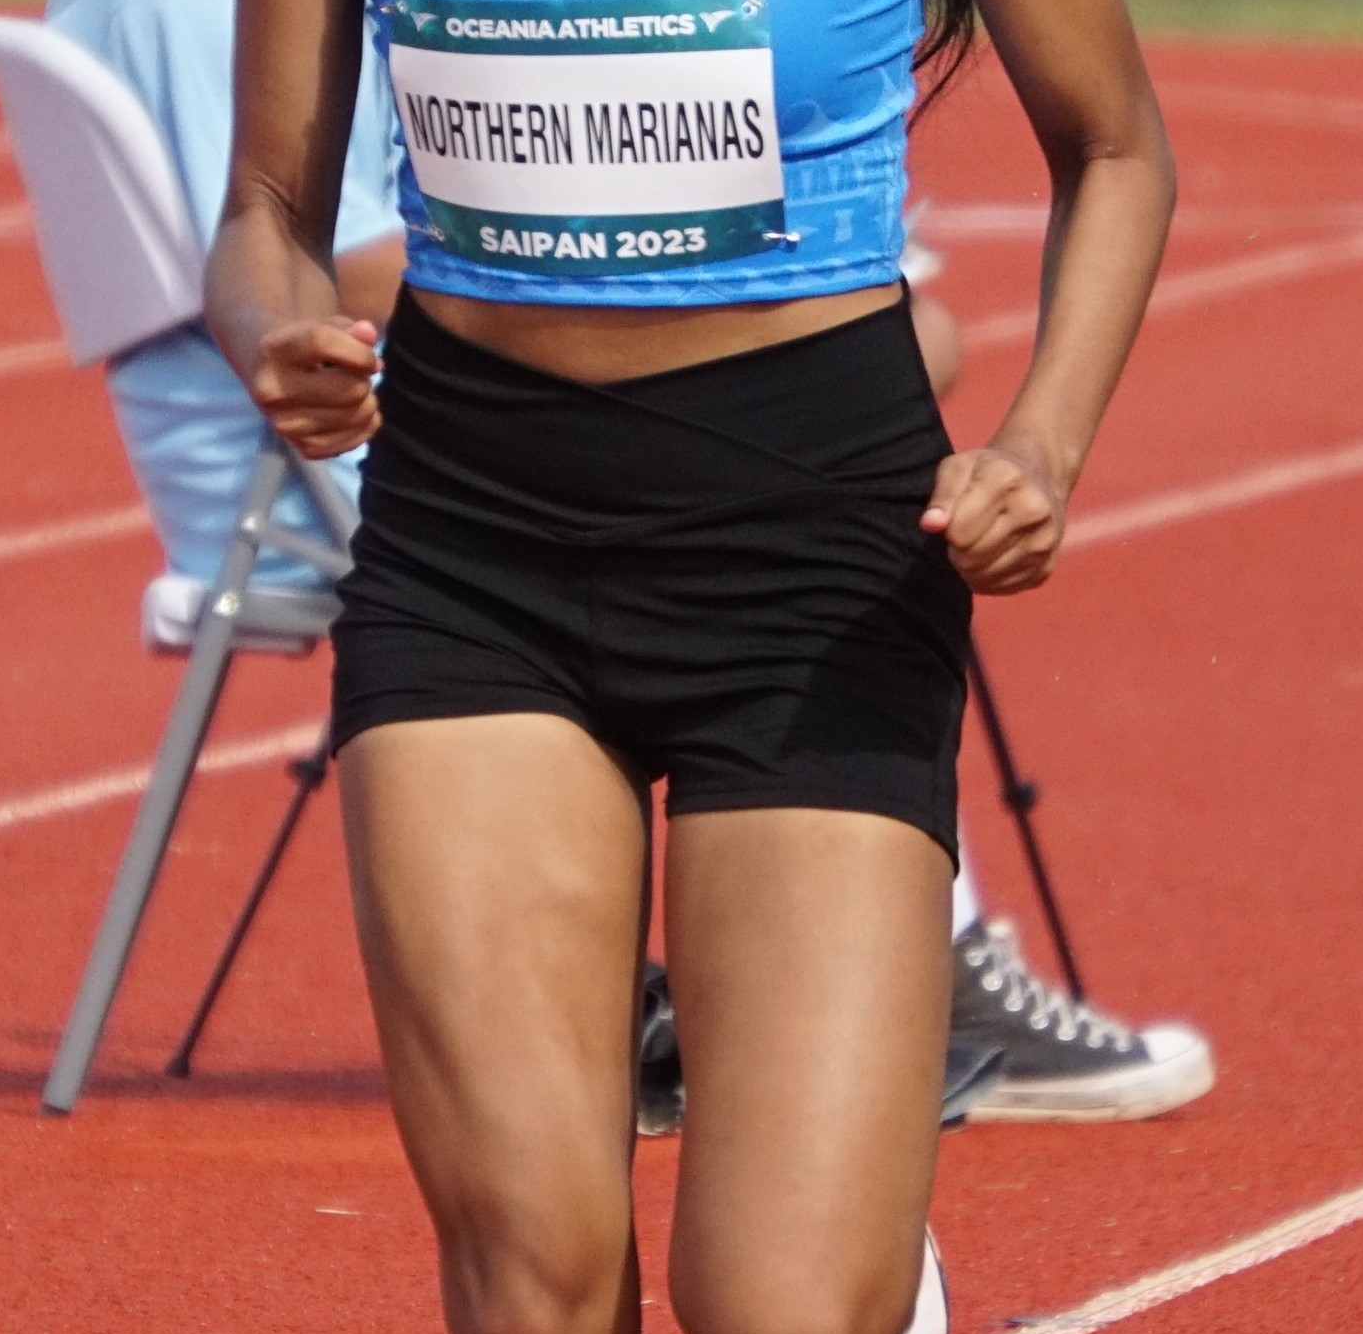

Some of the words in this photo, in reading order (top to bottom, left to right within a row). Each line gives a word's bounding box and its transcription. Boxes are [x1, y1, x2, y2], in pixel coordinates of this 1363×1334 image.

[444, 15, 554, 41] OCEANIA
[555, 12, 697, 41] ATHLETICS
[405, 91, 575, 166] NORTHERN
[584, 98, 765, 166] MARIANAS
[478, 226, 609, 261] SAIPAN
[614, 226, 707, 260] 2023
